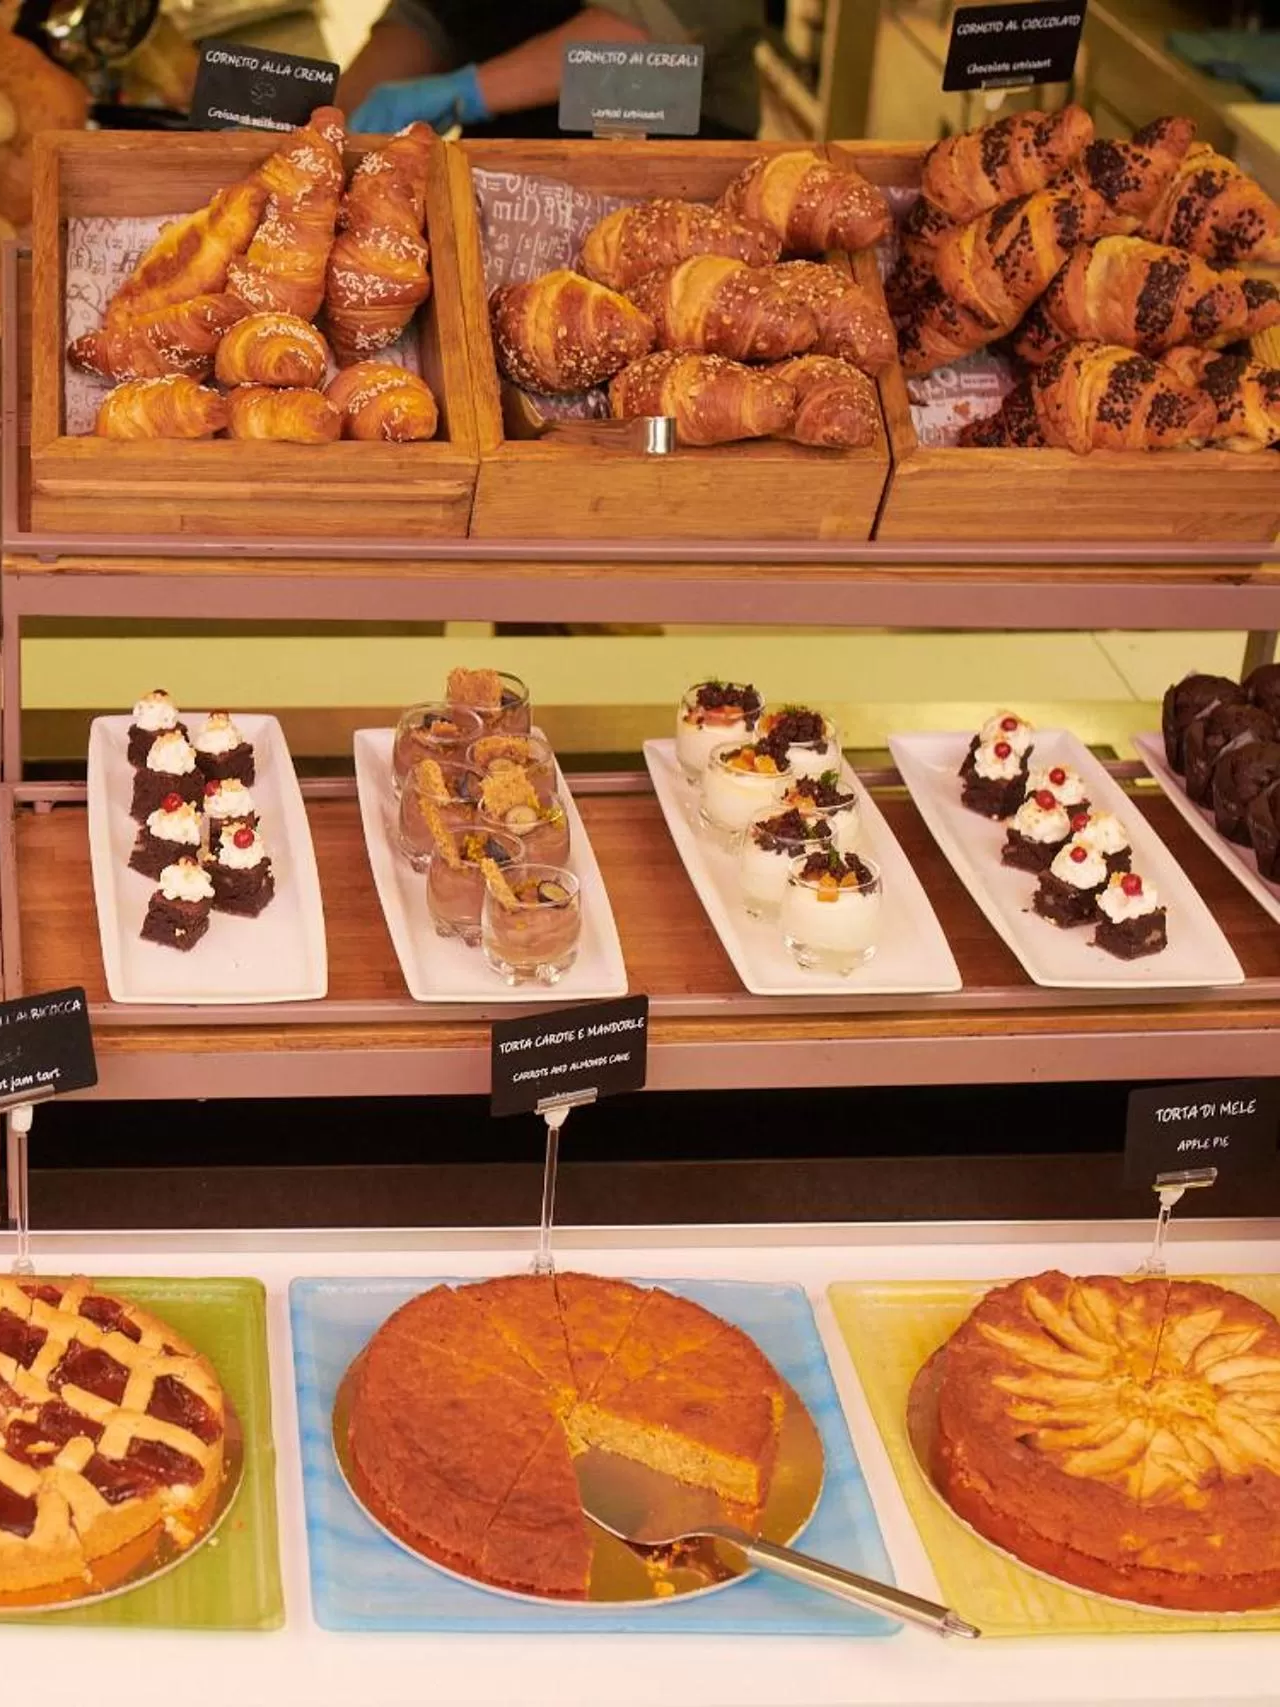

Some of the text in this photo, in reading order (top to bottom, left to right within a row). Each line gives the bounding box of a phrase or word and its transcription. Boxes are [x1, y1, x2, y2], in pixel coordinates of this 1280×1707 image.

[1005, 20, 1019, 31] AL
[205, 50, 334, 85] CORNETTO ALLA CREMA
[568, 50, 699, 67] CORNETTO AI CEREALI
[499, 1017, 645, 1055] TORTA CAROTE E MANDORLE
[512, 1051, 631, 1082] CARROTS AND ALMONDS CAKE
[10, 1075, 34, 1092] jam
[36, 1067, 61, 1081] tart
[1155, 1099, 1257, 1122] TORTA DI MELE
[1177, 1135, 1230, 1152] APPLE PIE
